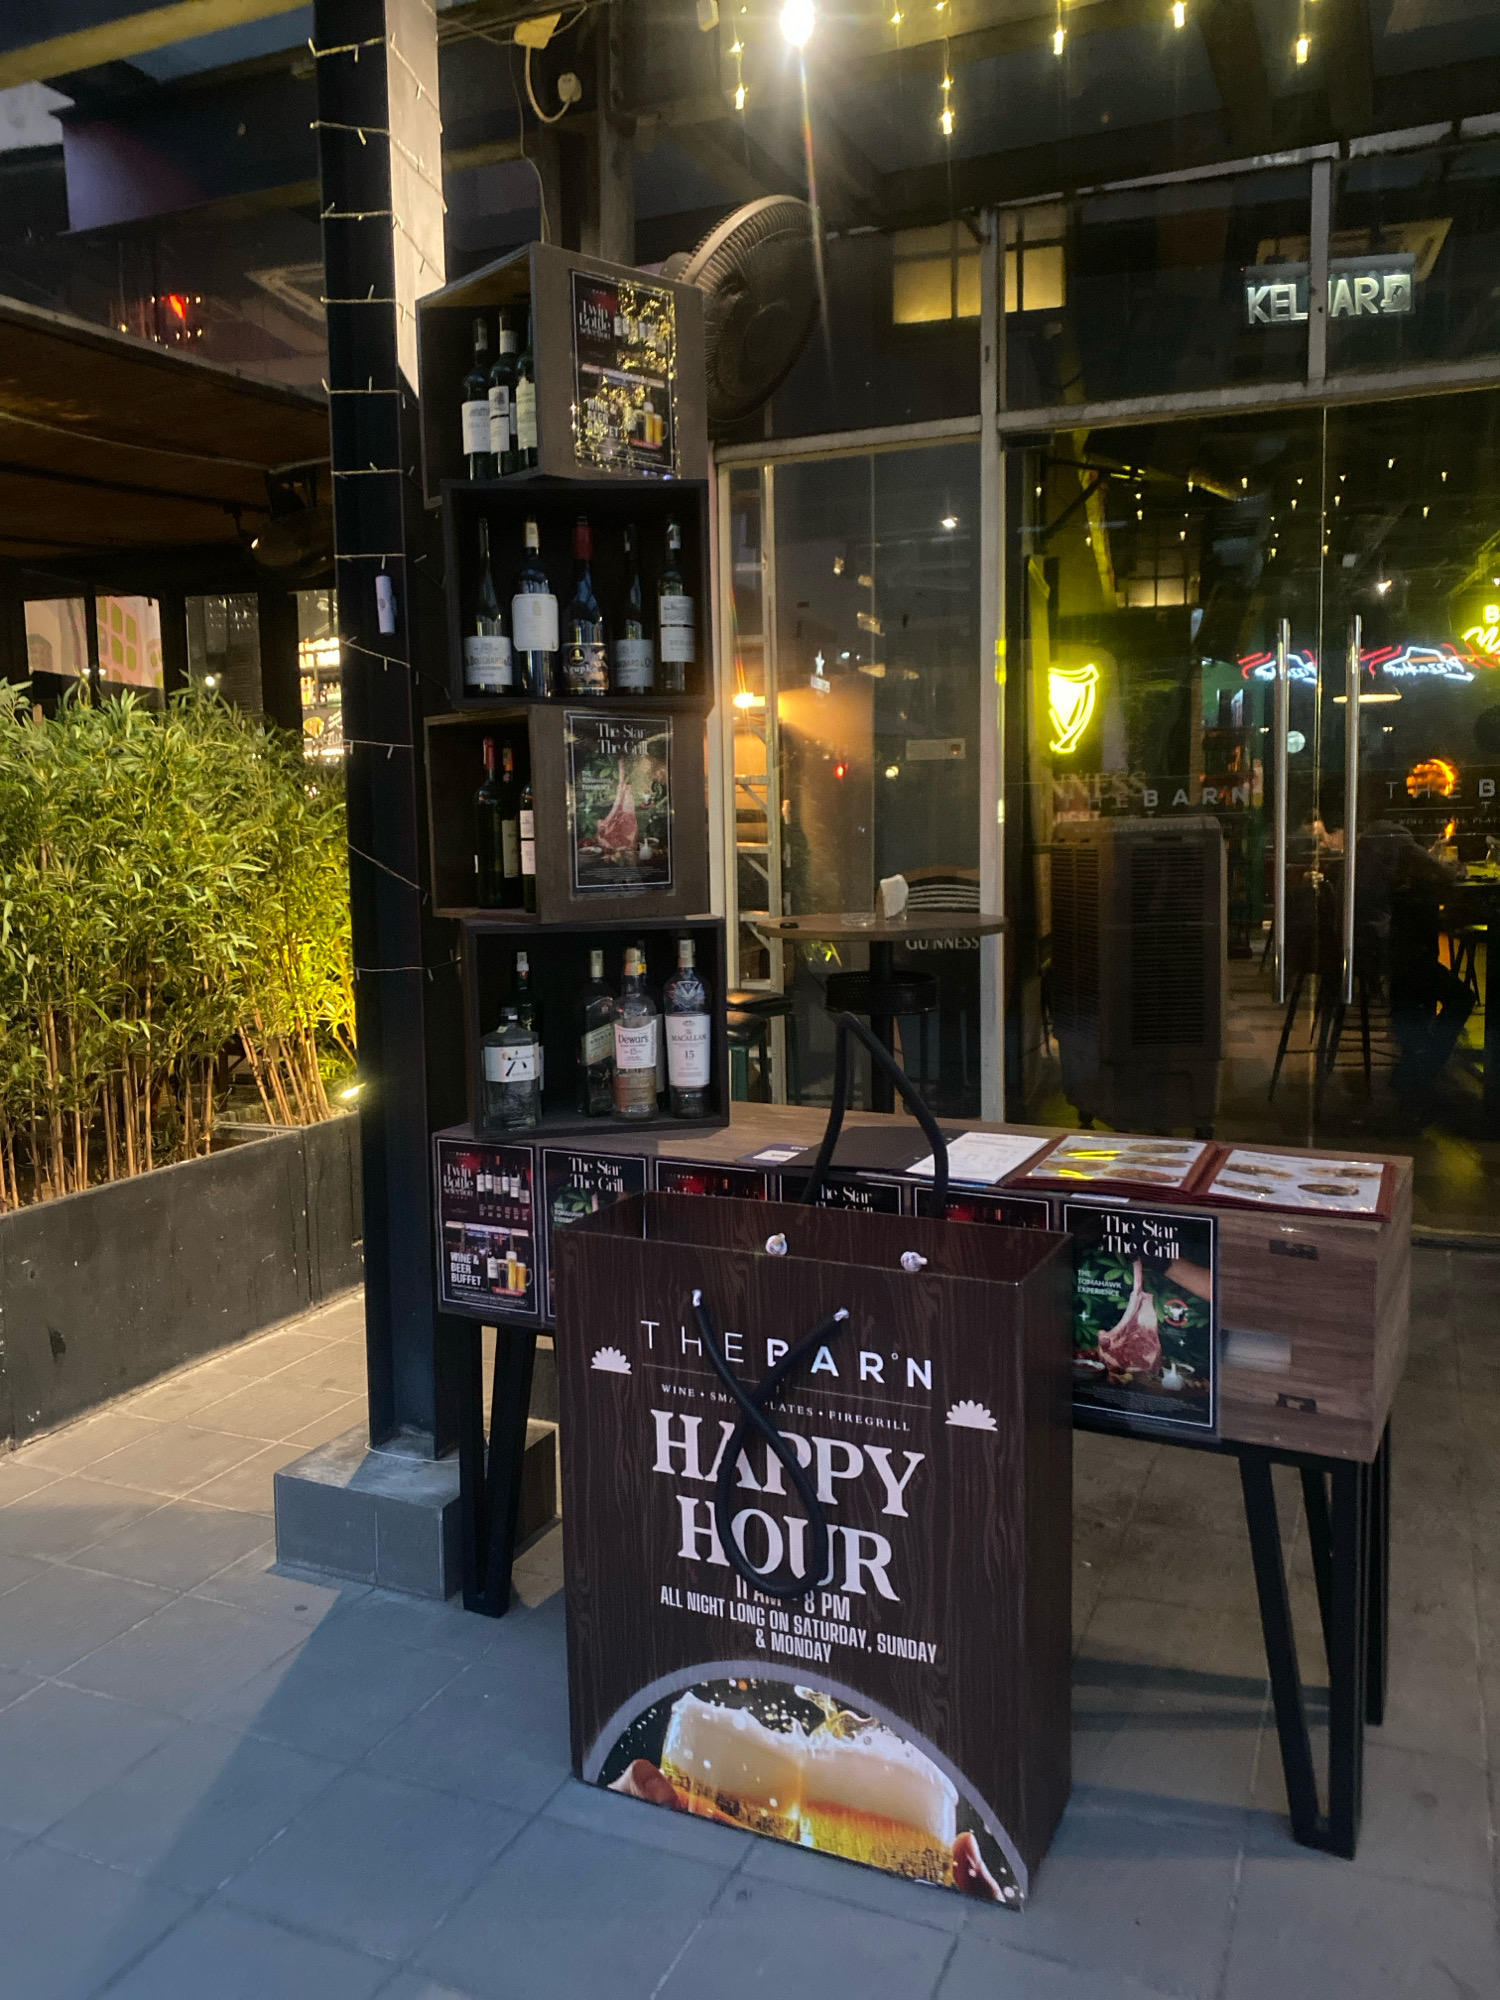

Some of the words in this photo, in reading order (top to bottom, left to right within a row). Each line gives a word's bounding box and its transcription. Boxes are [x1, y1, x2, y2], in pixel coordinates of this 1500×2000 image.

[1247, 277, 1379, 324] KELAR
[596, 723, 620, 739] The
[623, 724, 646, 739] Star
[596, 740, 622, 754] The
[1143, 786, 1250, 808] BARN
[905, 937, 980, 950] GUNNESS
[618, 1033, 649, 1045] Dewar's
[671, 1033, 708, 1042] MACALLAN
[684, 1050, 695, 1059] 15
[446, 1163, 471, 1178] Twin
[569, 1156, 593, 1173] The
[597, 1160, 622, 1177] Star
[443, 1174, 474, 1190] Bottle
[570, 1173, 594, 1189] The
[598, 1176, 624, 1193] Grill
[820, 1184, 838, 1201] he
[842, 1186, 873, 1205] Star
[1101, 1214, 1136, 1235] The
[1142, 1218, 1178, 1240] Star
[1100, 1234, 1137, 1255] The
[1143, 1239, 1180, 1260] Grill
[450, 1251, 472, 1264] WINE
[473, 1255, 480, 1265] &
[450, 1262, 472, 1274] BEER
[1077, 1269, 1091, 1277] THE
[450, 1272, 482, 1286] BUFFET
[1077, 1277, 1122, 1290] TOMAHAWK
[1077, 1286, 1120, 1297] EXPERIENCE
[640, 1320, 745, 1364] THE
[661, 1382, 696, 1398] WINE
[764, 1400, 814, 1417] LATES
[828, 1409, 911, 1432] FIREGRILL
[650, 1408, 926, 1518] HAPPY
[675, 1494, 901, 1601] HOUR
[803, 1589, 815, 1614] 8
[821, 1591, 851, 1622] PM
[660, 1584, 684, 1608] ALL
[687, 1590, 725, 1618] NIGHT
[729, 1602, 766, 1627] LONG
[769, 1610, 789, 1633] ON
[793, 1614, 872, 1652] SATURDAY,
[877, 1633, 938, 1664] SUNDAY
[755, 1628, 766, 1649] &
[771, 1631, 832, 1663] MONDAY
